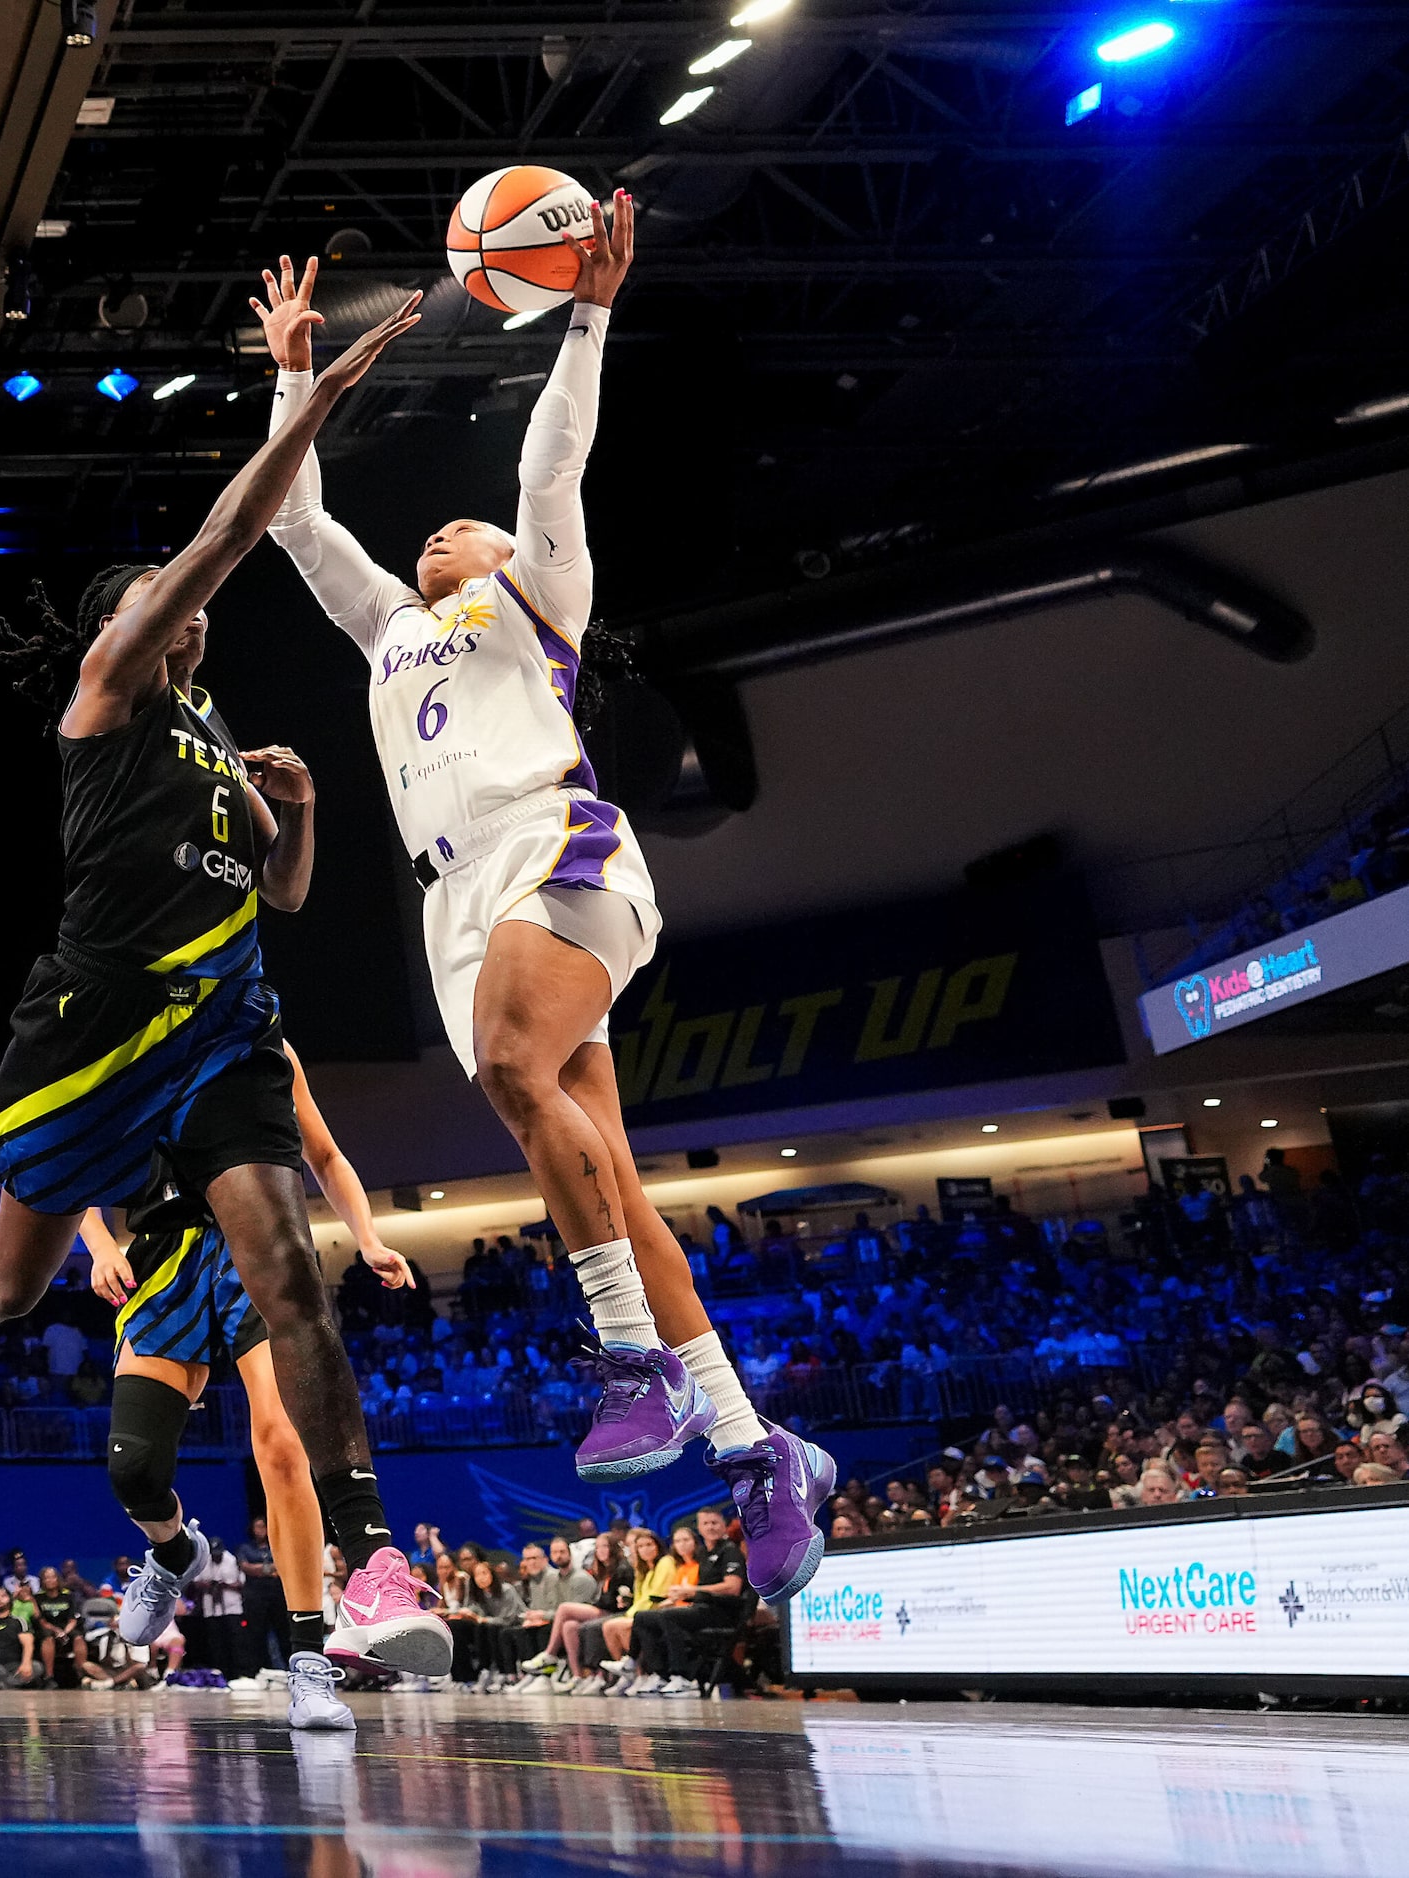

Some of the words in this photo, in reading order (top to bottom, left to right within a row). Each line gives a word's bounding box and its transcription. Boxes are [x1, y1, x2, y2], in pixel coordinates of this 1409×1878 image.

[537, 198, 592, 232] Wil
[417, 677, 449, 741] 6
[211, 783, 230, 844] 6
[854, 950, 1020, 1063] UP
[1213, 987, 1266, 1020] PEDIATRIC
[1263, 966, 1322, 1001] DENTISTRY
[801, 1585, 883, 1621] NextCare
[1120, 1562, 1256, 1610] NextCare
[1126, 1613, 1198, 1635] URGENT
[1203, 1612, 1257, 1633] CARE
